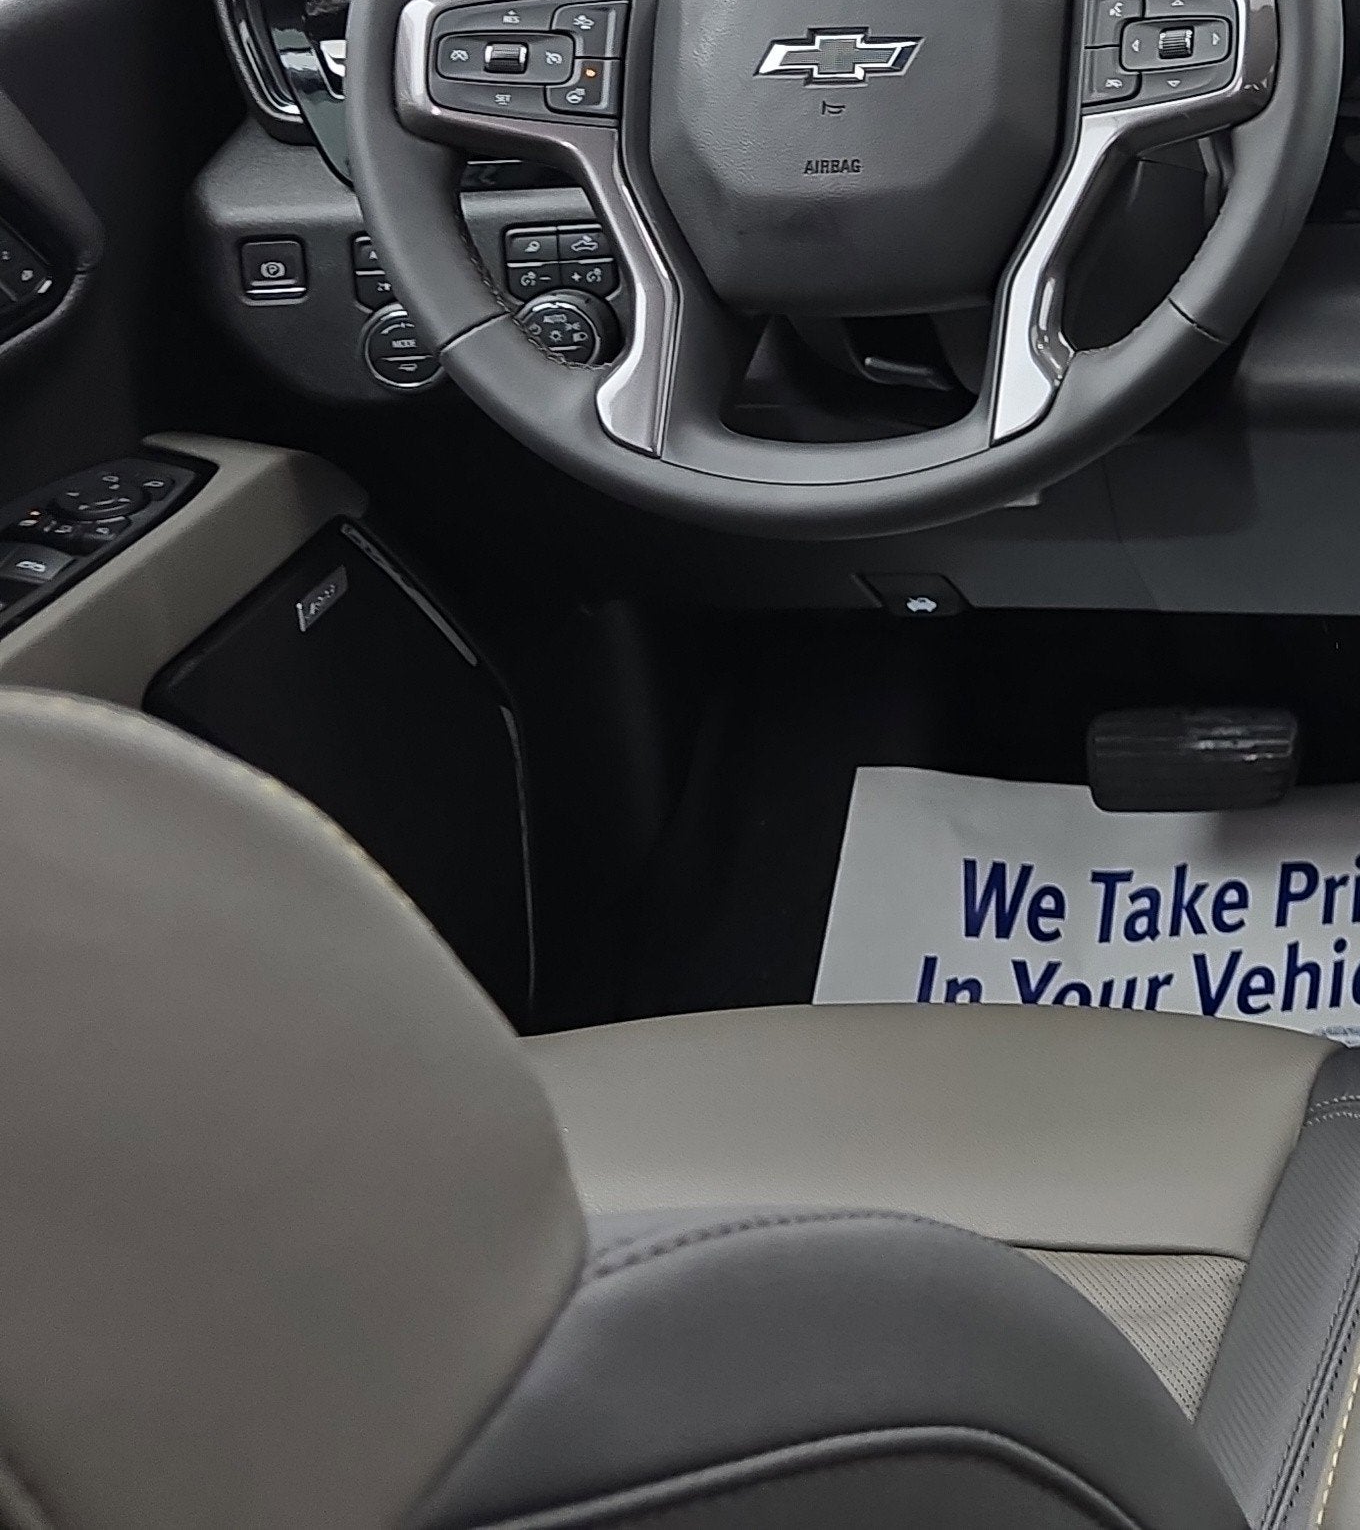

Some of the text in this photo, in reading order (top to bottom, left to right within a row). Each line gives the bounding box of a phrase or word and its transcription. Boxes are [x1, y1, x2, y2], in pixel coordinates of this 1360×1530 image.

[803, 159, 863, 174] AIRBAG
[392, 339, 416, 348] MODE
[962, 857, 1067, 944] We
[1090, 862, 1250, 944] Take
